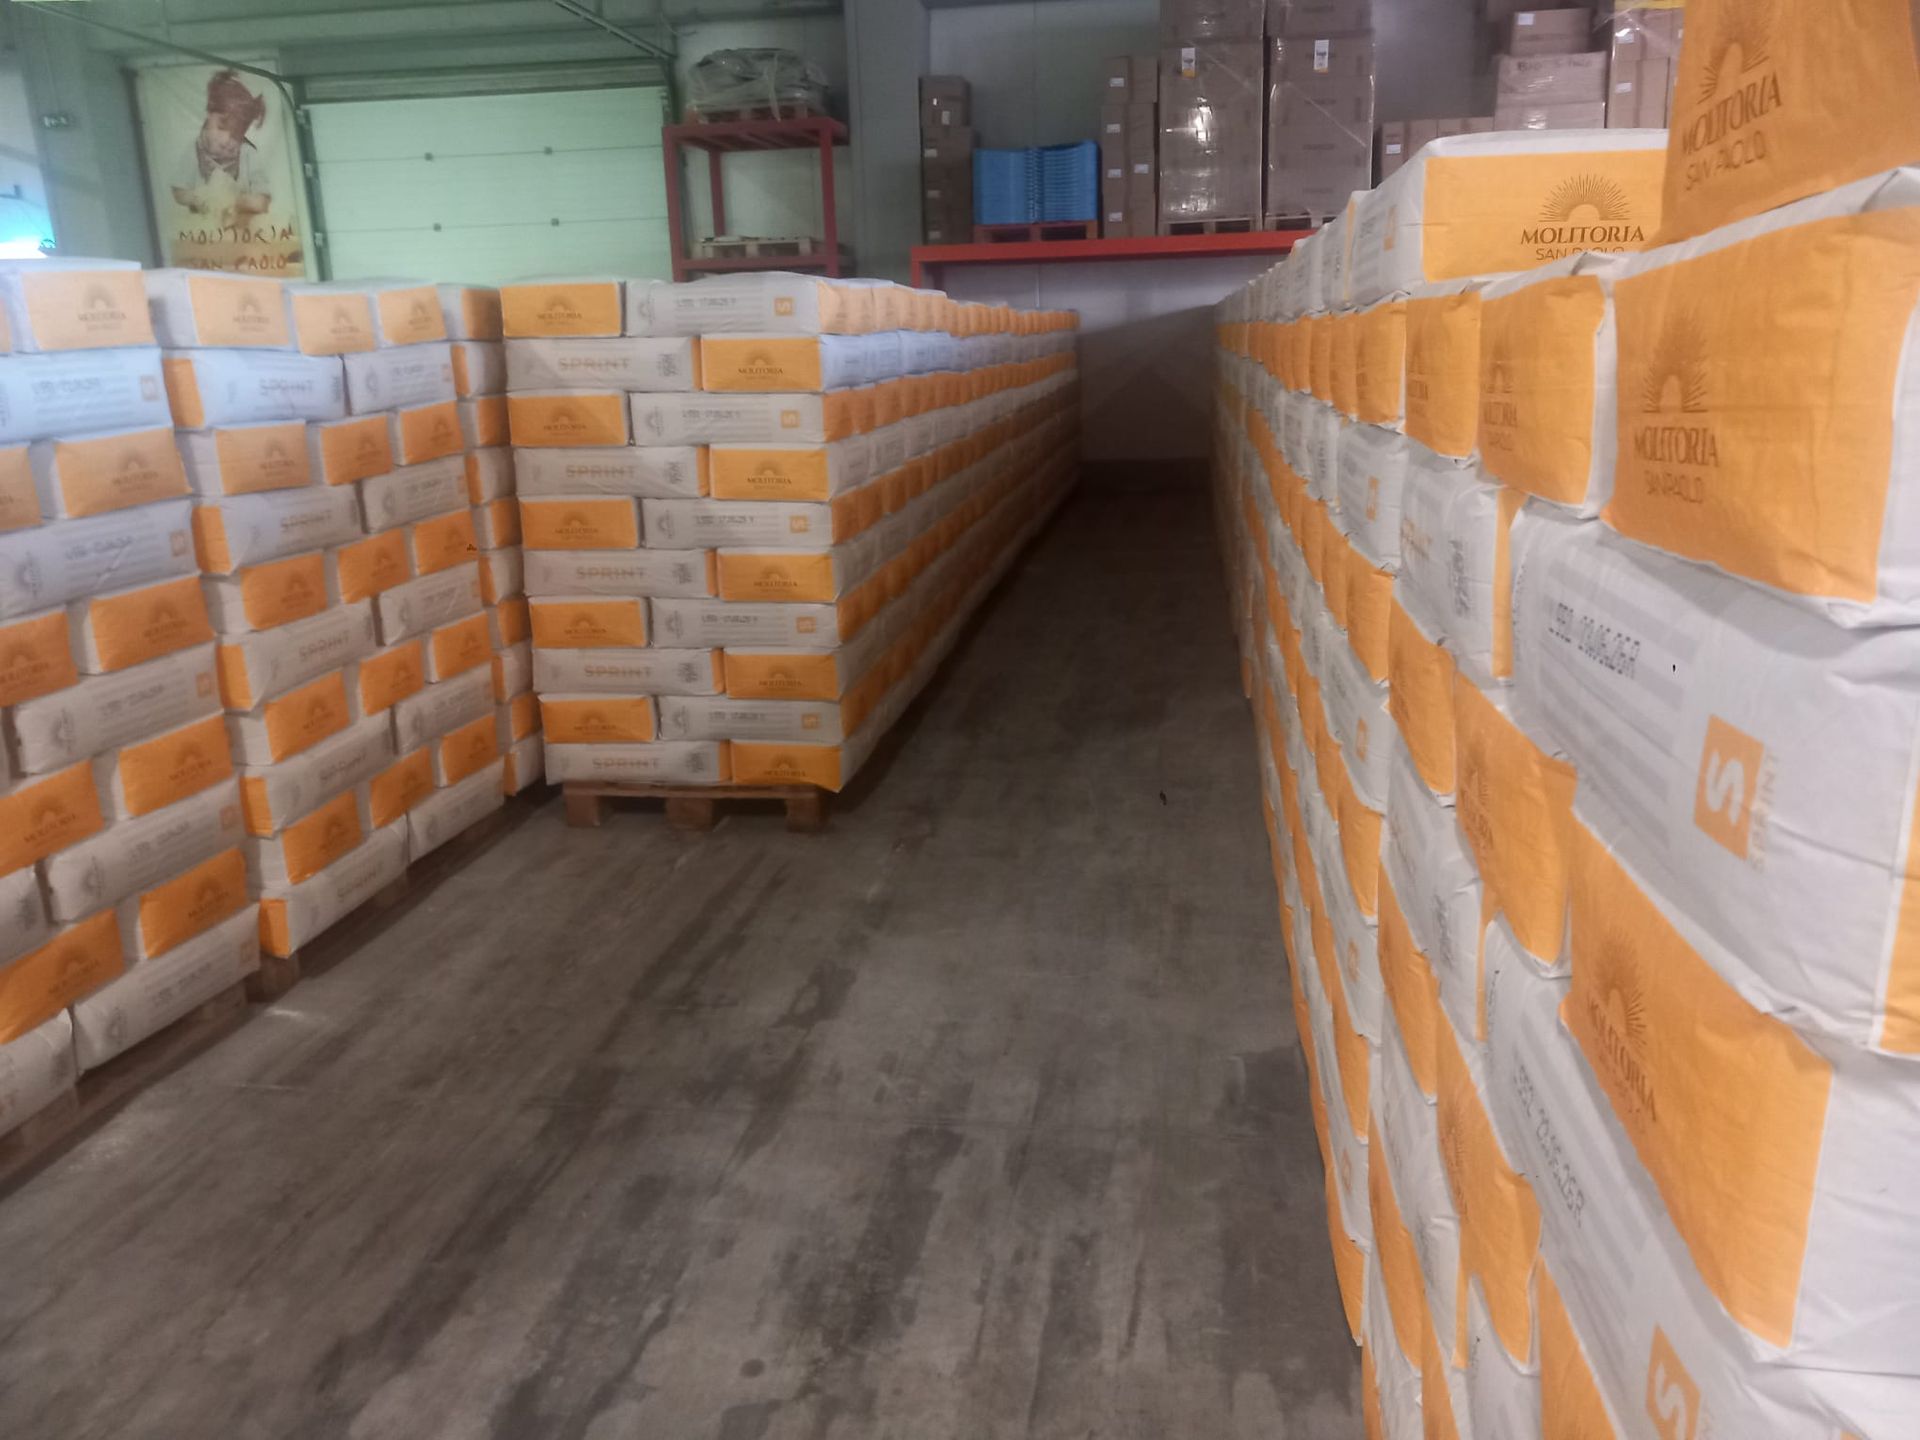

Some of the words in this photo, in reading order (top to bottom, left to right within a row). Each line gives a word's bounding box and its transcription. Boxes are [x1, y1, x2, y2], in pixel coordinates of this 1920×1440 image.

[1682, 70, 1783, 155] MOLITORIA
[1686, 161, 1711, 191] SAN
[1715, 130, 1768, 171] PAOLO
[179, 224, 293, 245] MOLITORIA
[1520, 225, 1645, 245] MOLITORIA
[1535, 247, 1567, 261] SAN
[234, 254, 288, 270] PAOLO
[557, 357, 632, 372] SPRINT
[737, 366, 784, 376] MOLITORIA
[1634, 426, 1720, 468] MOLITORIA
[565, 464, 636, 478] SPRINT
[746, 475, 793, 485] MOLITORIA
[575, 566, 647, 580] SPRINT
[583, 664, 653, 678] SPRINT
